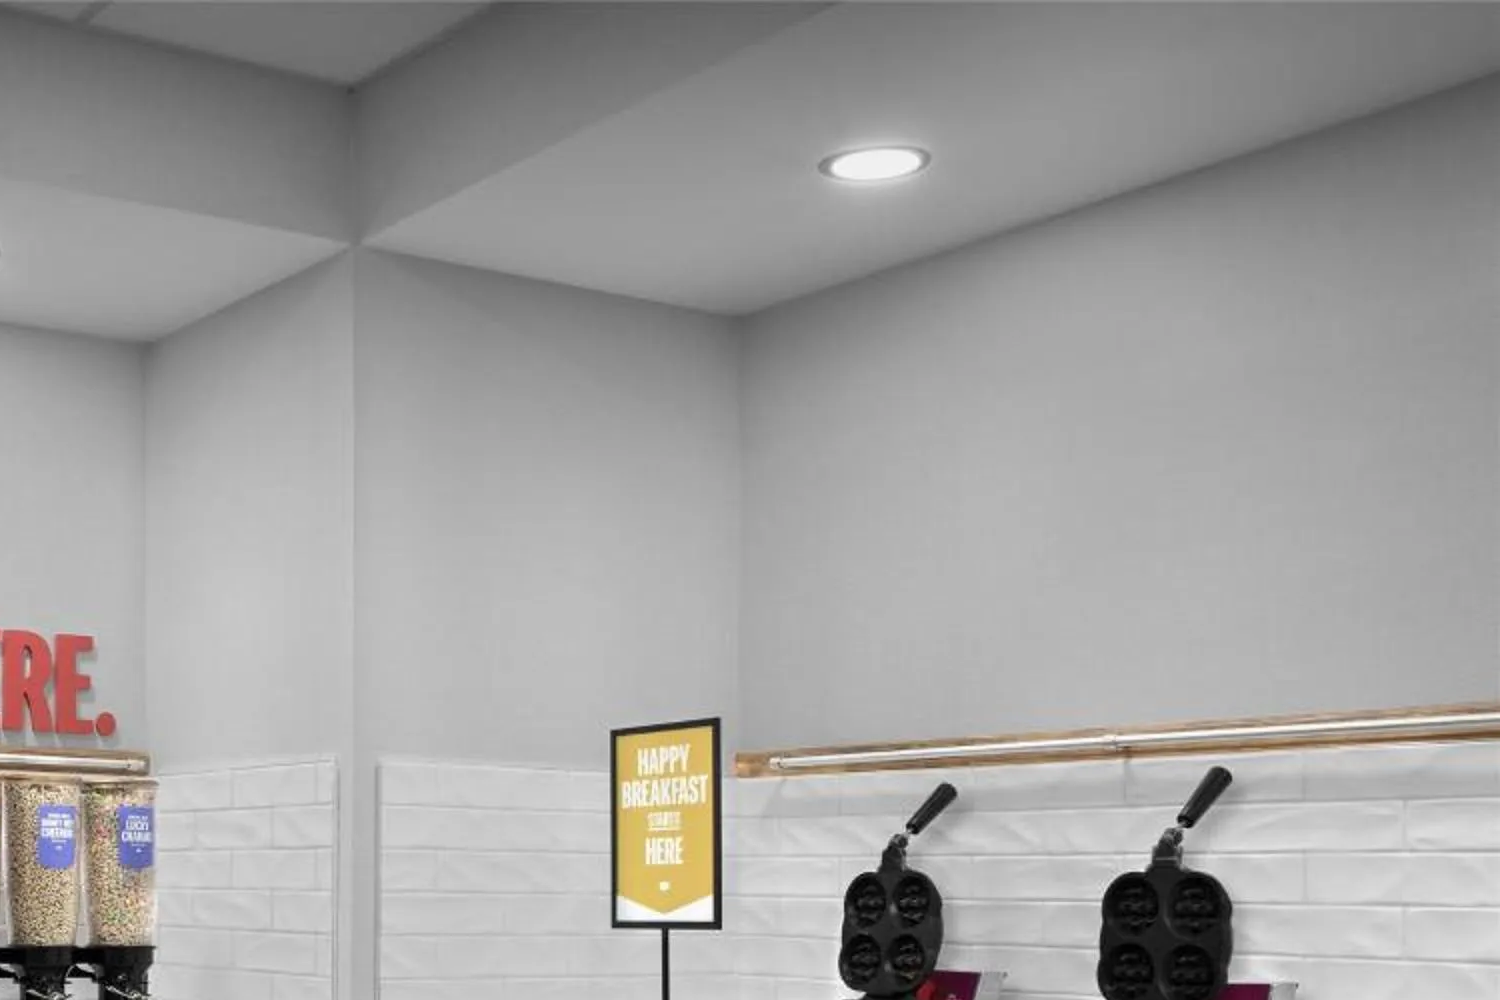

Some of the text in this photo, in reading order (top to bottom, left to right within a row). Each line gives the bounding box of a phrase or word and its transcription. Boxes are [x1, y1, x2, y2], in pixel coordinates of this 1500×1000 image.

[636, 744, 691, 776] HAPPY
[621, 775, 709, 809] BREAKFAST
[644, 836, 684, 865] HERE
